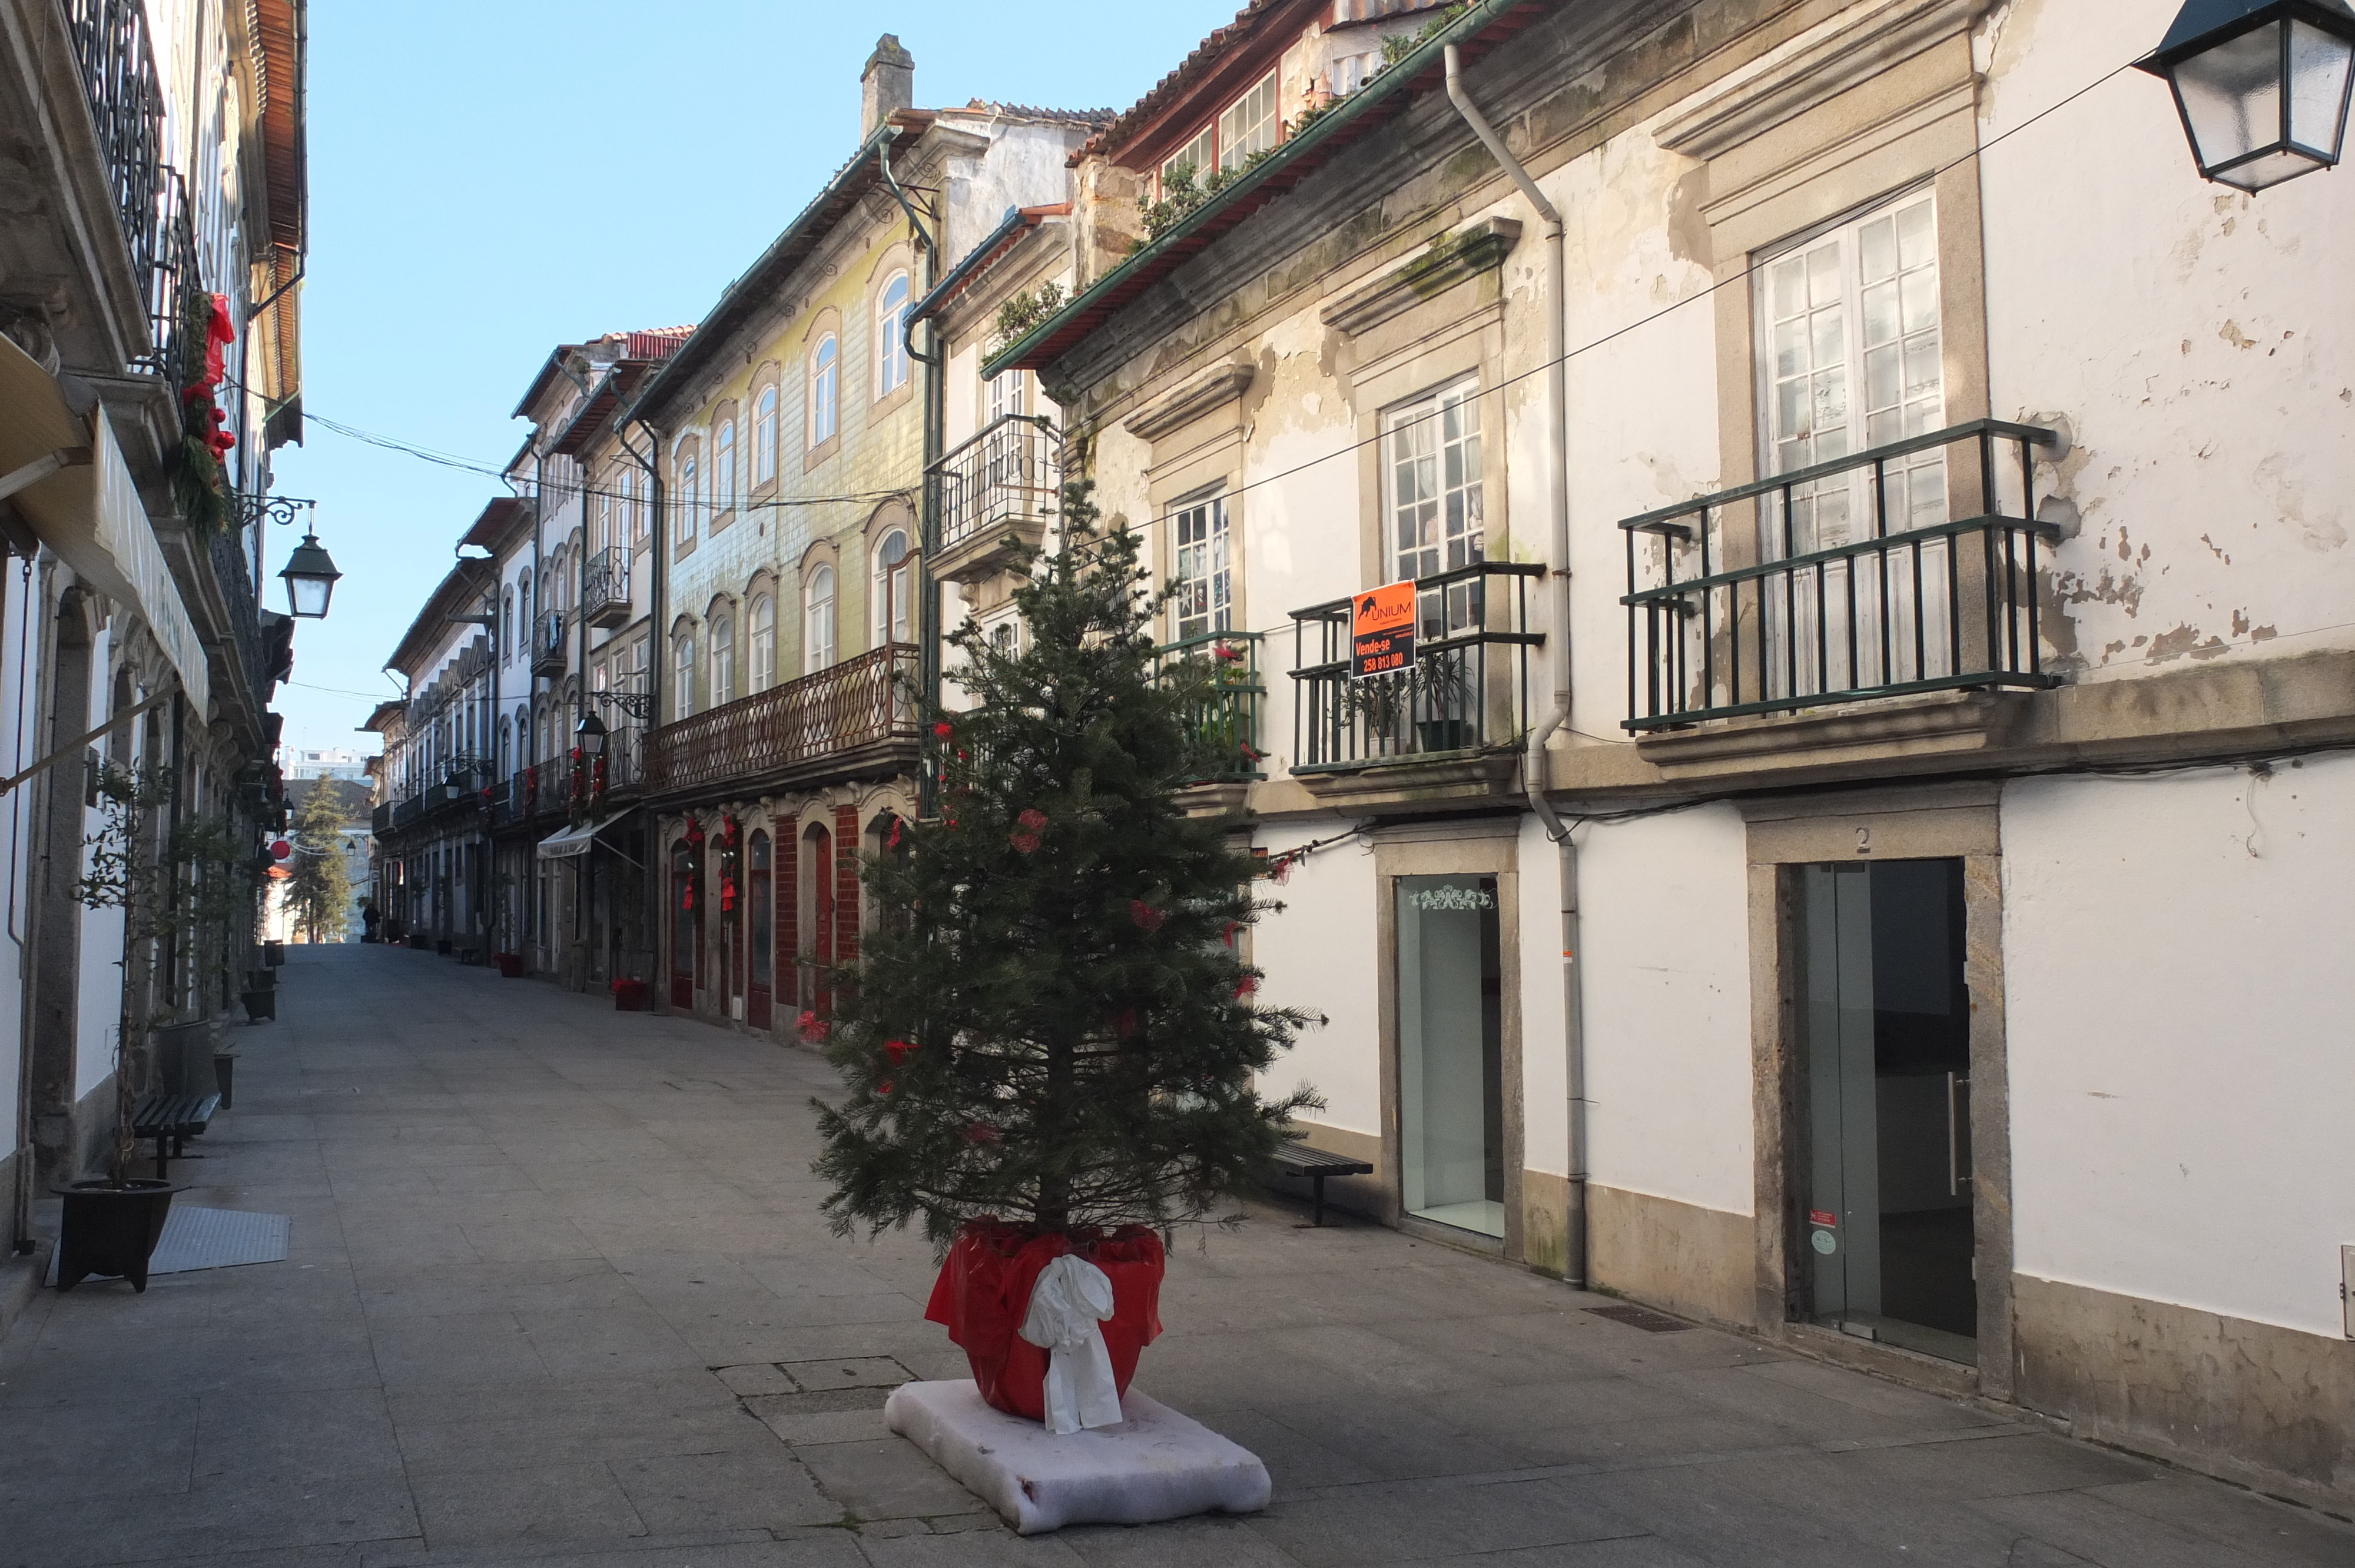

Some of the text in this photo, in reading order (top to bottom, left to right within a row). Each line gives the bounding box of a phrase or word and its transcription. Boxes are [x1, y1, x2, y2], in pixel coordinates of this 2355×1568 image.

[1372, 602, 1411, 620] UNIUM
[1356, 639, 1390, 656] Vende-se
[1364, 652, 1403, 672] 258 813 080
[1856, 828, 1870, 853] 2
